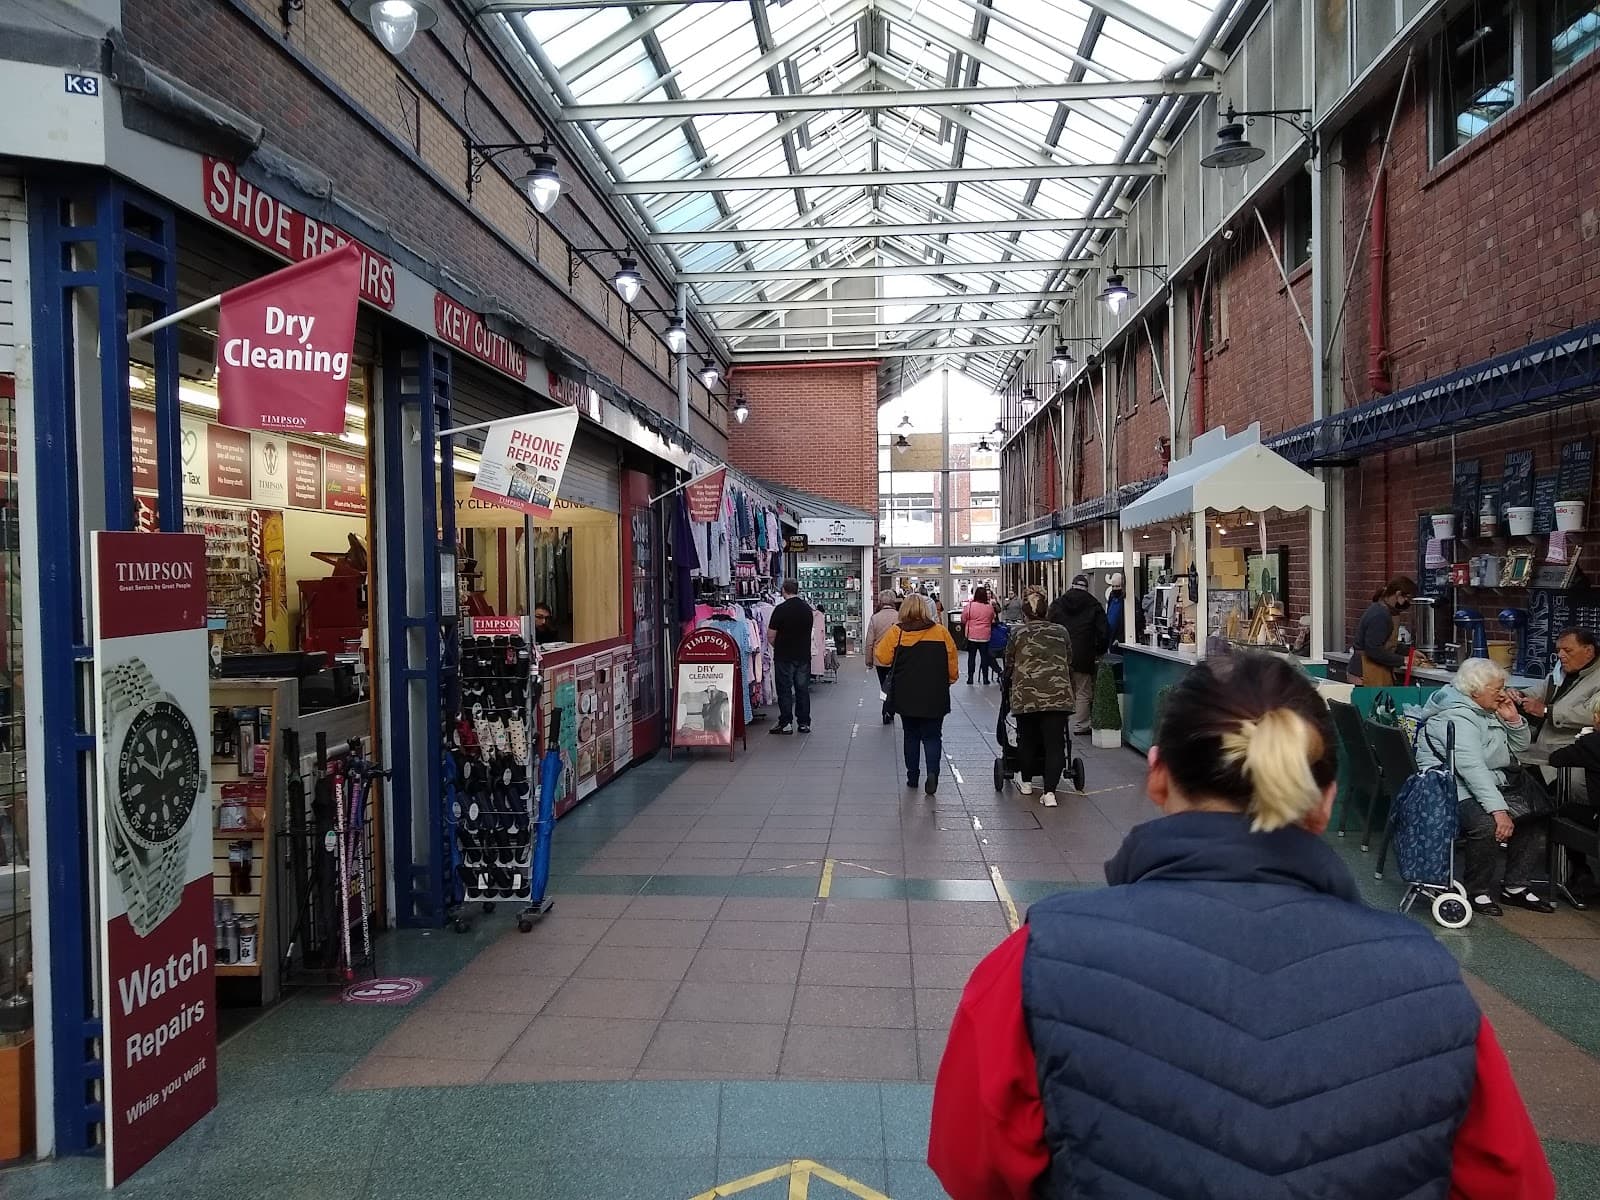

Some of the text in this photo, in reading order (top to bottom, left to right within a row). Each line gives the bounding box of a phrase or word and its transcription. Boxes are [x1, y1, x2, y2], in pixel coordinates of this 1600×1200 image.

[67, 75, 96, 94] K3
[210, 162, 394, 304] SHOE REIRS
[265, 306, 315, 344] Dry
[443, 301, 524, 378] KEY CUTTING
[223, 338, 348, 381] Cleaning
[261, 414, 307, 425] TIMPSON
[506, 446, 561, 472] REPAIRS
[510, 429, 565, 458] PHONE
[187, 472, 200, 485] Tax
[115, 561, 193, 582] TIMPSON
[251, 509, 264, 628] HOUHOLD
[474, 619, 521, 629] TIMPSON
[684, 635, 730, 651] TIMPSON
[1526, 591, 1549, 679] DRINKS
[118, 937, 208, 1017] Watch
[126, 1000, 205, 1069] Repairs
[126, 1056, 207, 1125] While you wait
